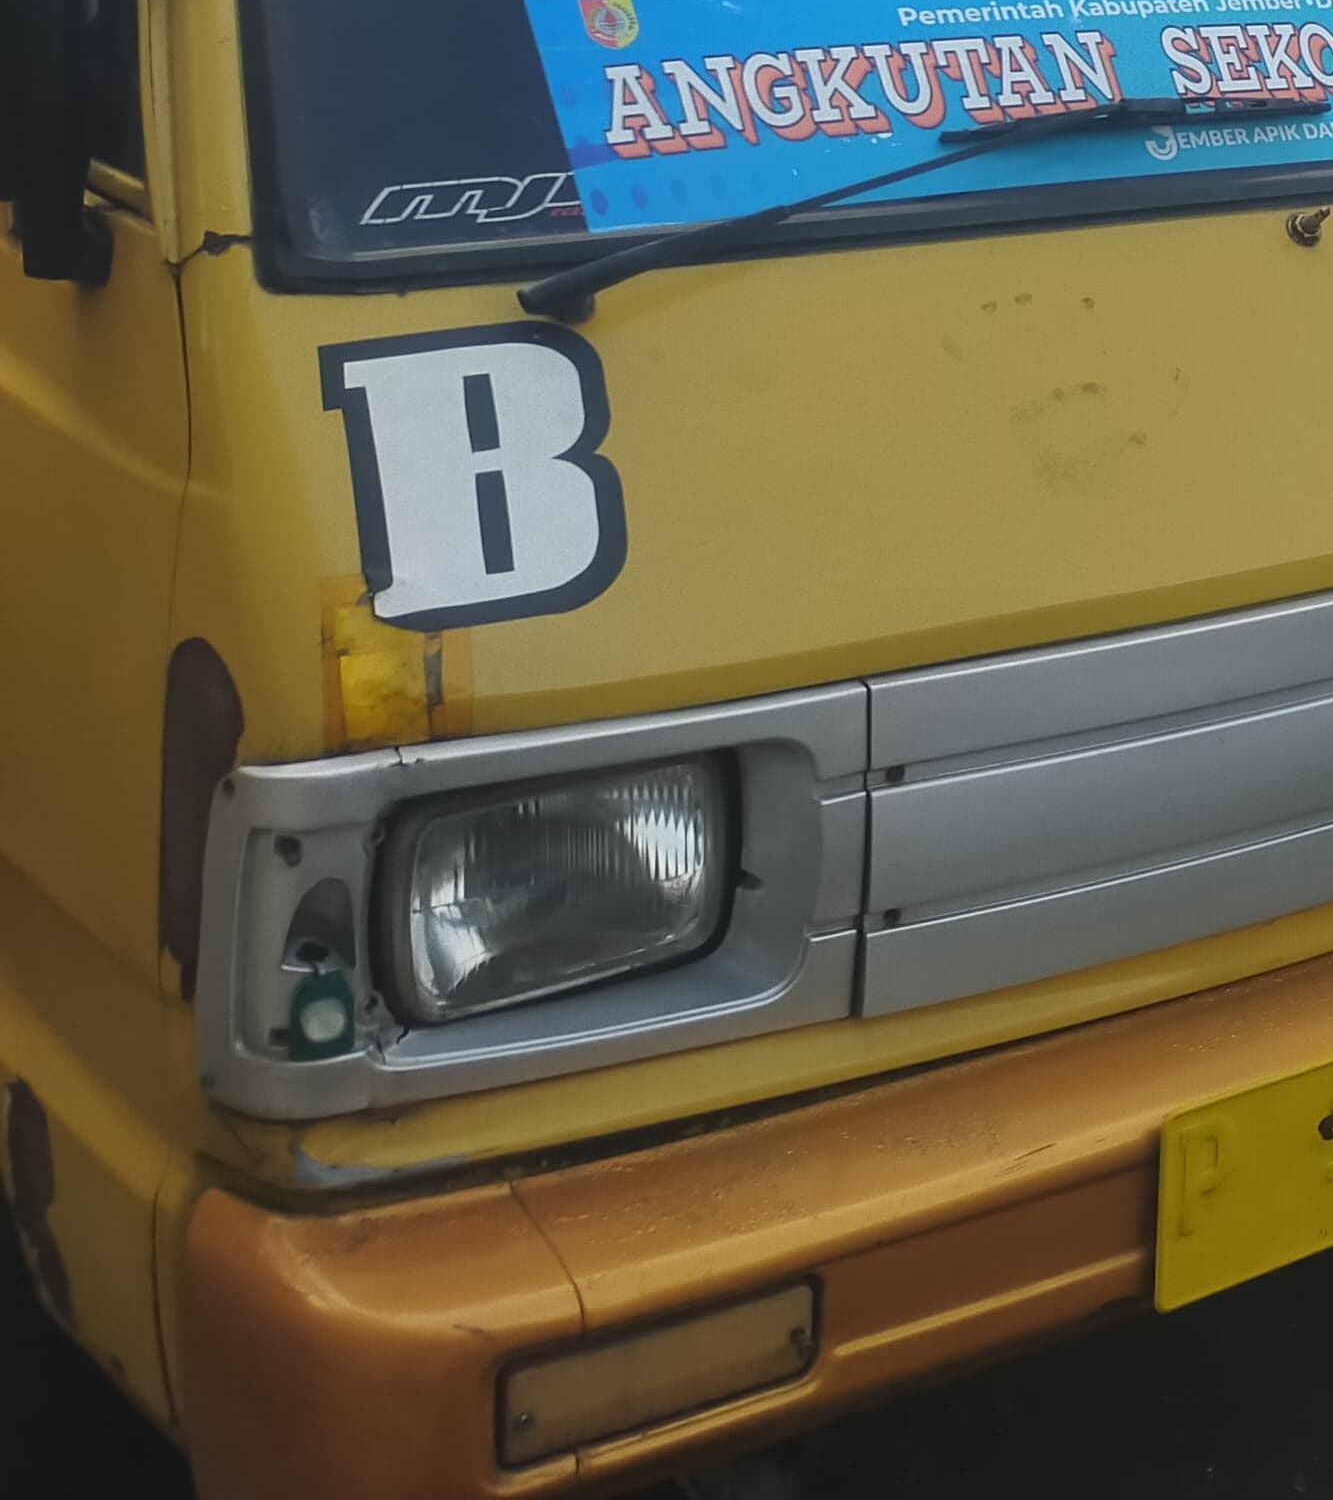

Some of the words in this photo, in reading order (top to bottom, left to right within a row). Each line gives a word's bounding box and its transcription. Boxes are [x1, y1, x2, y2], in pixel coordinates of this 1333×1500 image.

[897, 0, 1064, 27] Pemerintah
[604, 30, 1121, 153] ANGKUTAN
[1252, 124, 1301, 144] APIK
[333, 334, 614, 624] B
